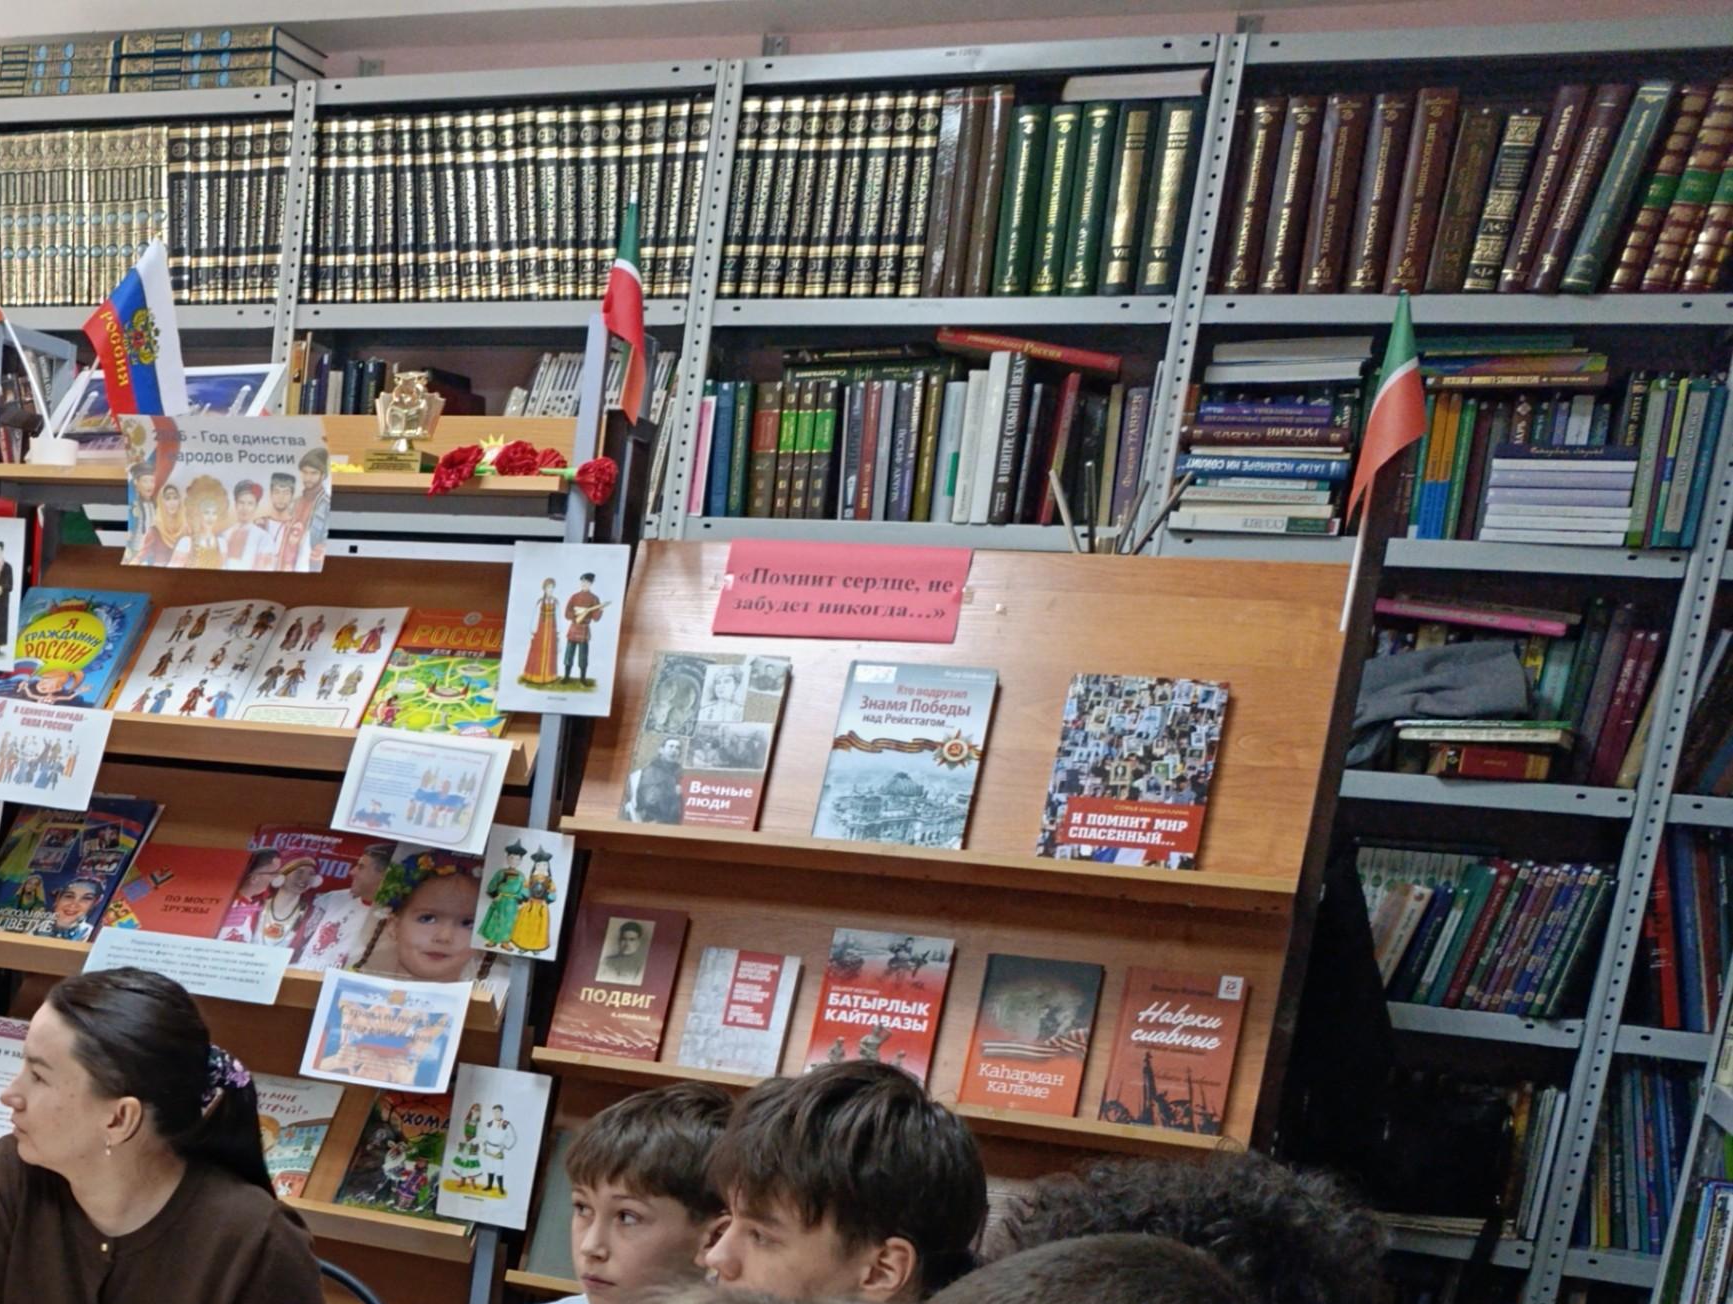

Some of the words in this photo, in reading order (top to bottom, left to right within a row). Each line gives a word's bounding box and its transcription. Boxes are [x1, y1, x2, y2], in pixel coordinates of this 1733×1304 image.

[100, 309, 129, 388] РОССИЯ
[200, 430, 229, 445] Год
[232, 432, 306, 447] единства
[170, 450, 234, 465] ародов
[237, 450, 296, 466] России
[739, 567, 837, 588] «Помнит
[841, 574, 921, 593] сердце,
[927, 579, 954, 594] не
[733, 595, 811, 615] забудет
[63, 616, 80, 630] Я
[24, 629, 103, 648] ГРАЖДАНИН
[24, 641, 93, 665] РОССИИ
[896, 684, 915, 696] Кто
[915, 686, 968, 700] водрузил
[859, 695, 908, 712] Знамя
[909, 697, 972, 718] Победы
[20, 717, 41, 728] СИЛА
[42, 719, 74, 732] РОССИИ
[862, 713, 883, 724] над
[689, 780, 754, 799] Вечные
[685, 796, 732, 811] люди
[1071, 812, 1084, 825] И
[1086, 813, 1152, 830] ПОМНИТ
[1153, 817, 1189, 833] МИР
[164, 894, 182, 904] ПО
[184, 895, 221, 905] МОСТУ
[579, 986, 656, 1010] ПОДВИГ
[827, 992, 931, 1017] БАТЫРЛЫК
[824, 1008, 929, 1033] КАЙТАВАЗЫ
[1137, 1001, 1223, 1030] Навеки
[1130, 1024, 1221, 1050] славные
[977, 1062, 1066, 1087] Каһарман
[986, 1080, 1051, 1099] каләме
